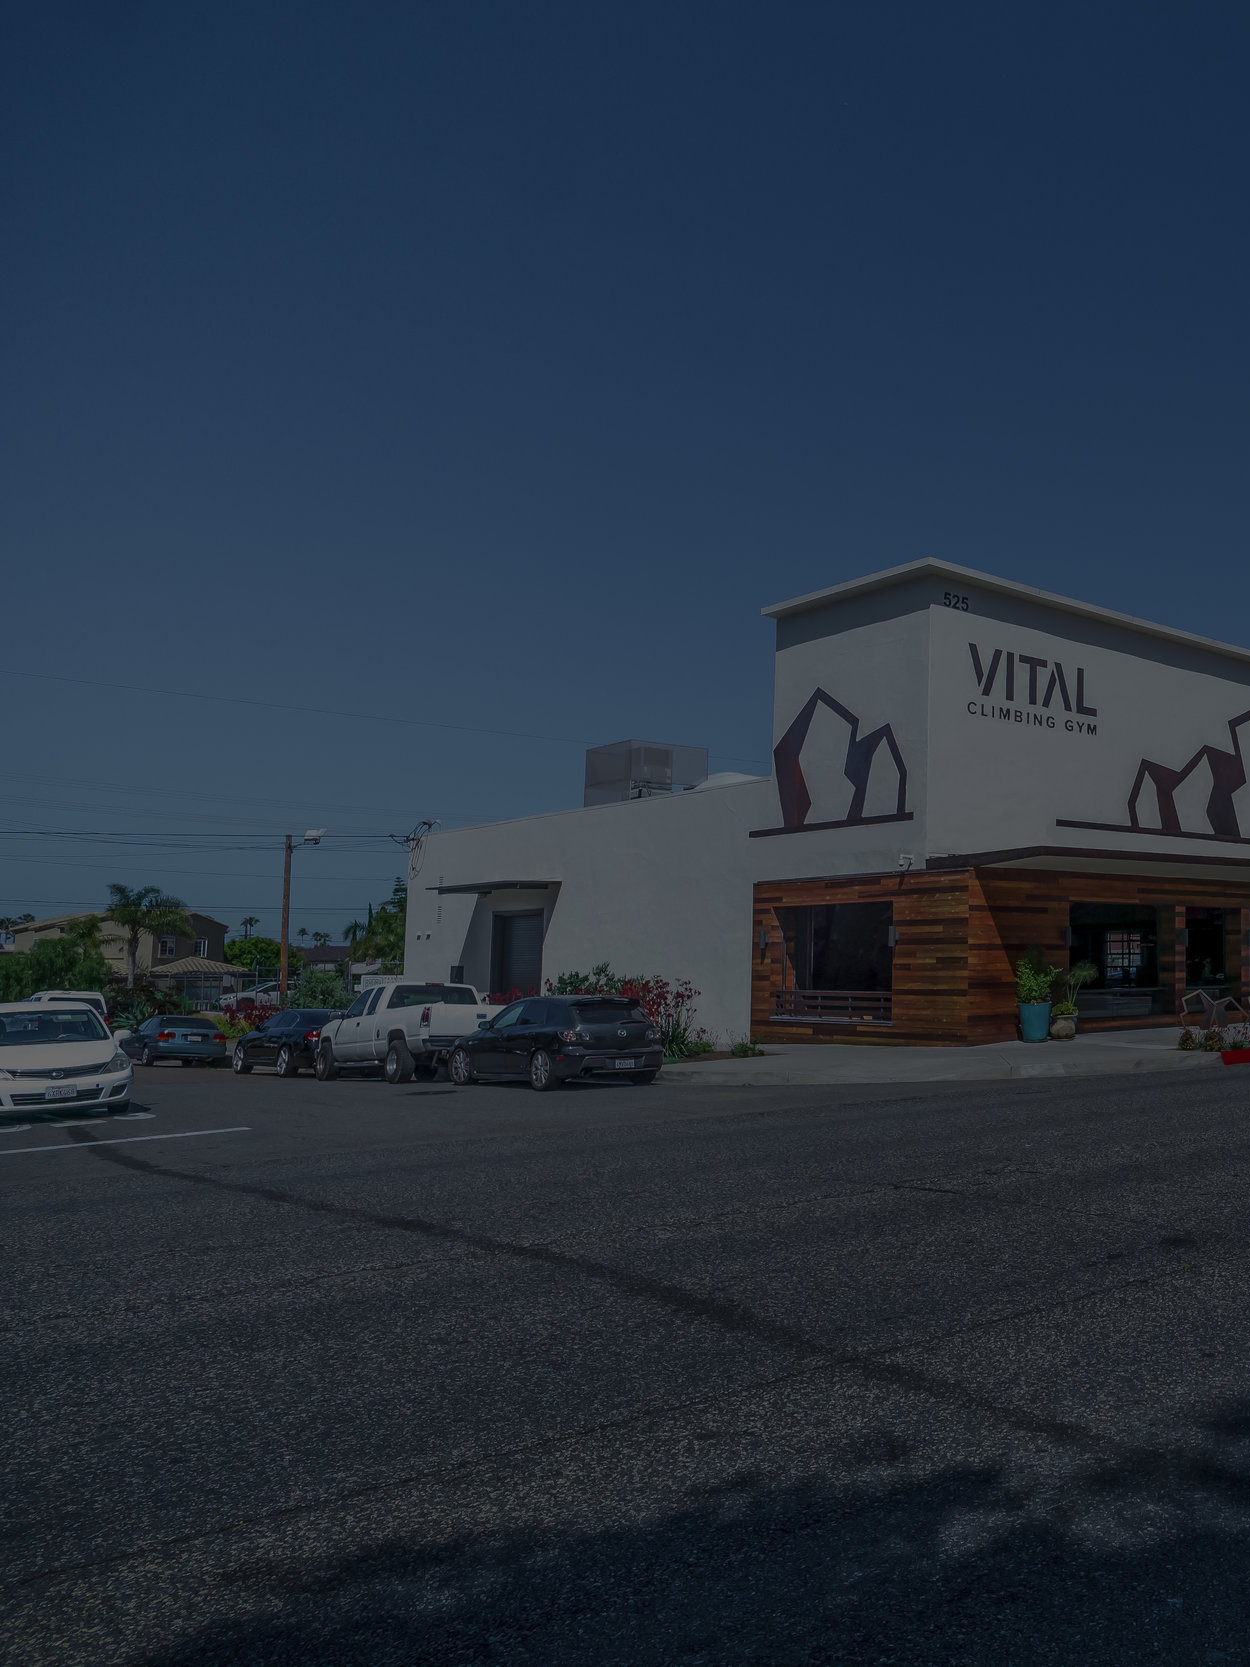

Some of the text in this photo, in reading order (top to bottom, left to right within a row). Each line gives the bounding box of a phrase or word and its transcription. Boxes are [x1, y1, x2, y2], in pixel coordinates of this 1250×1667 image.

[943, 592, 969, 612] 525
[968, 642, 1098, 718] VITAL
[967, 701, 1097, 735] CLIMBING GYM
